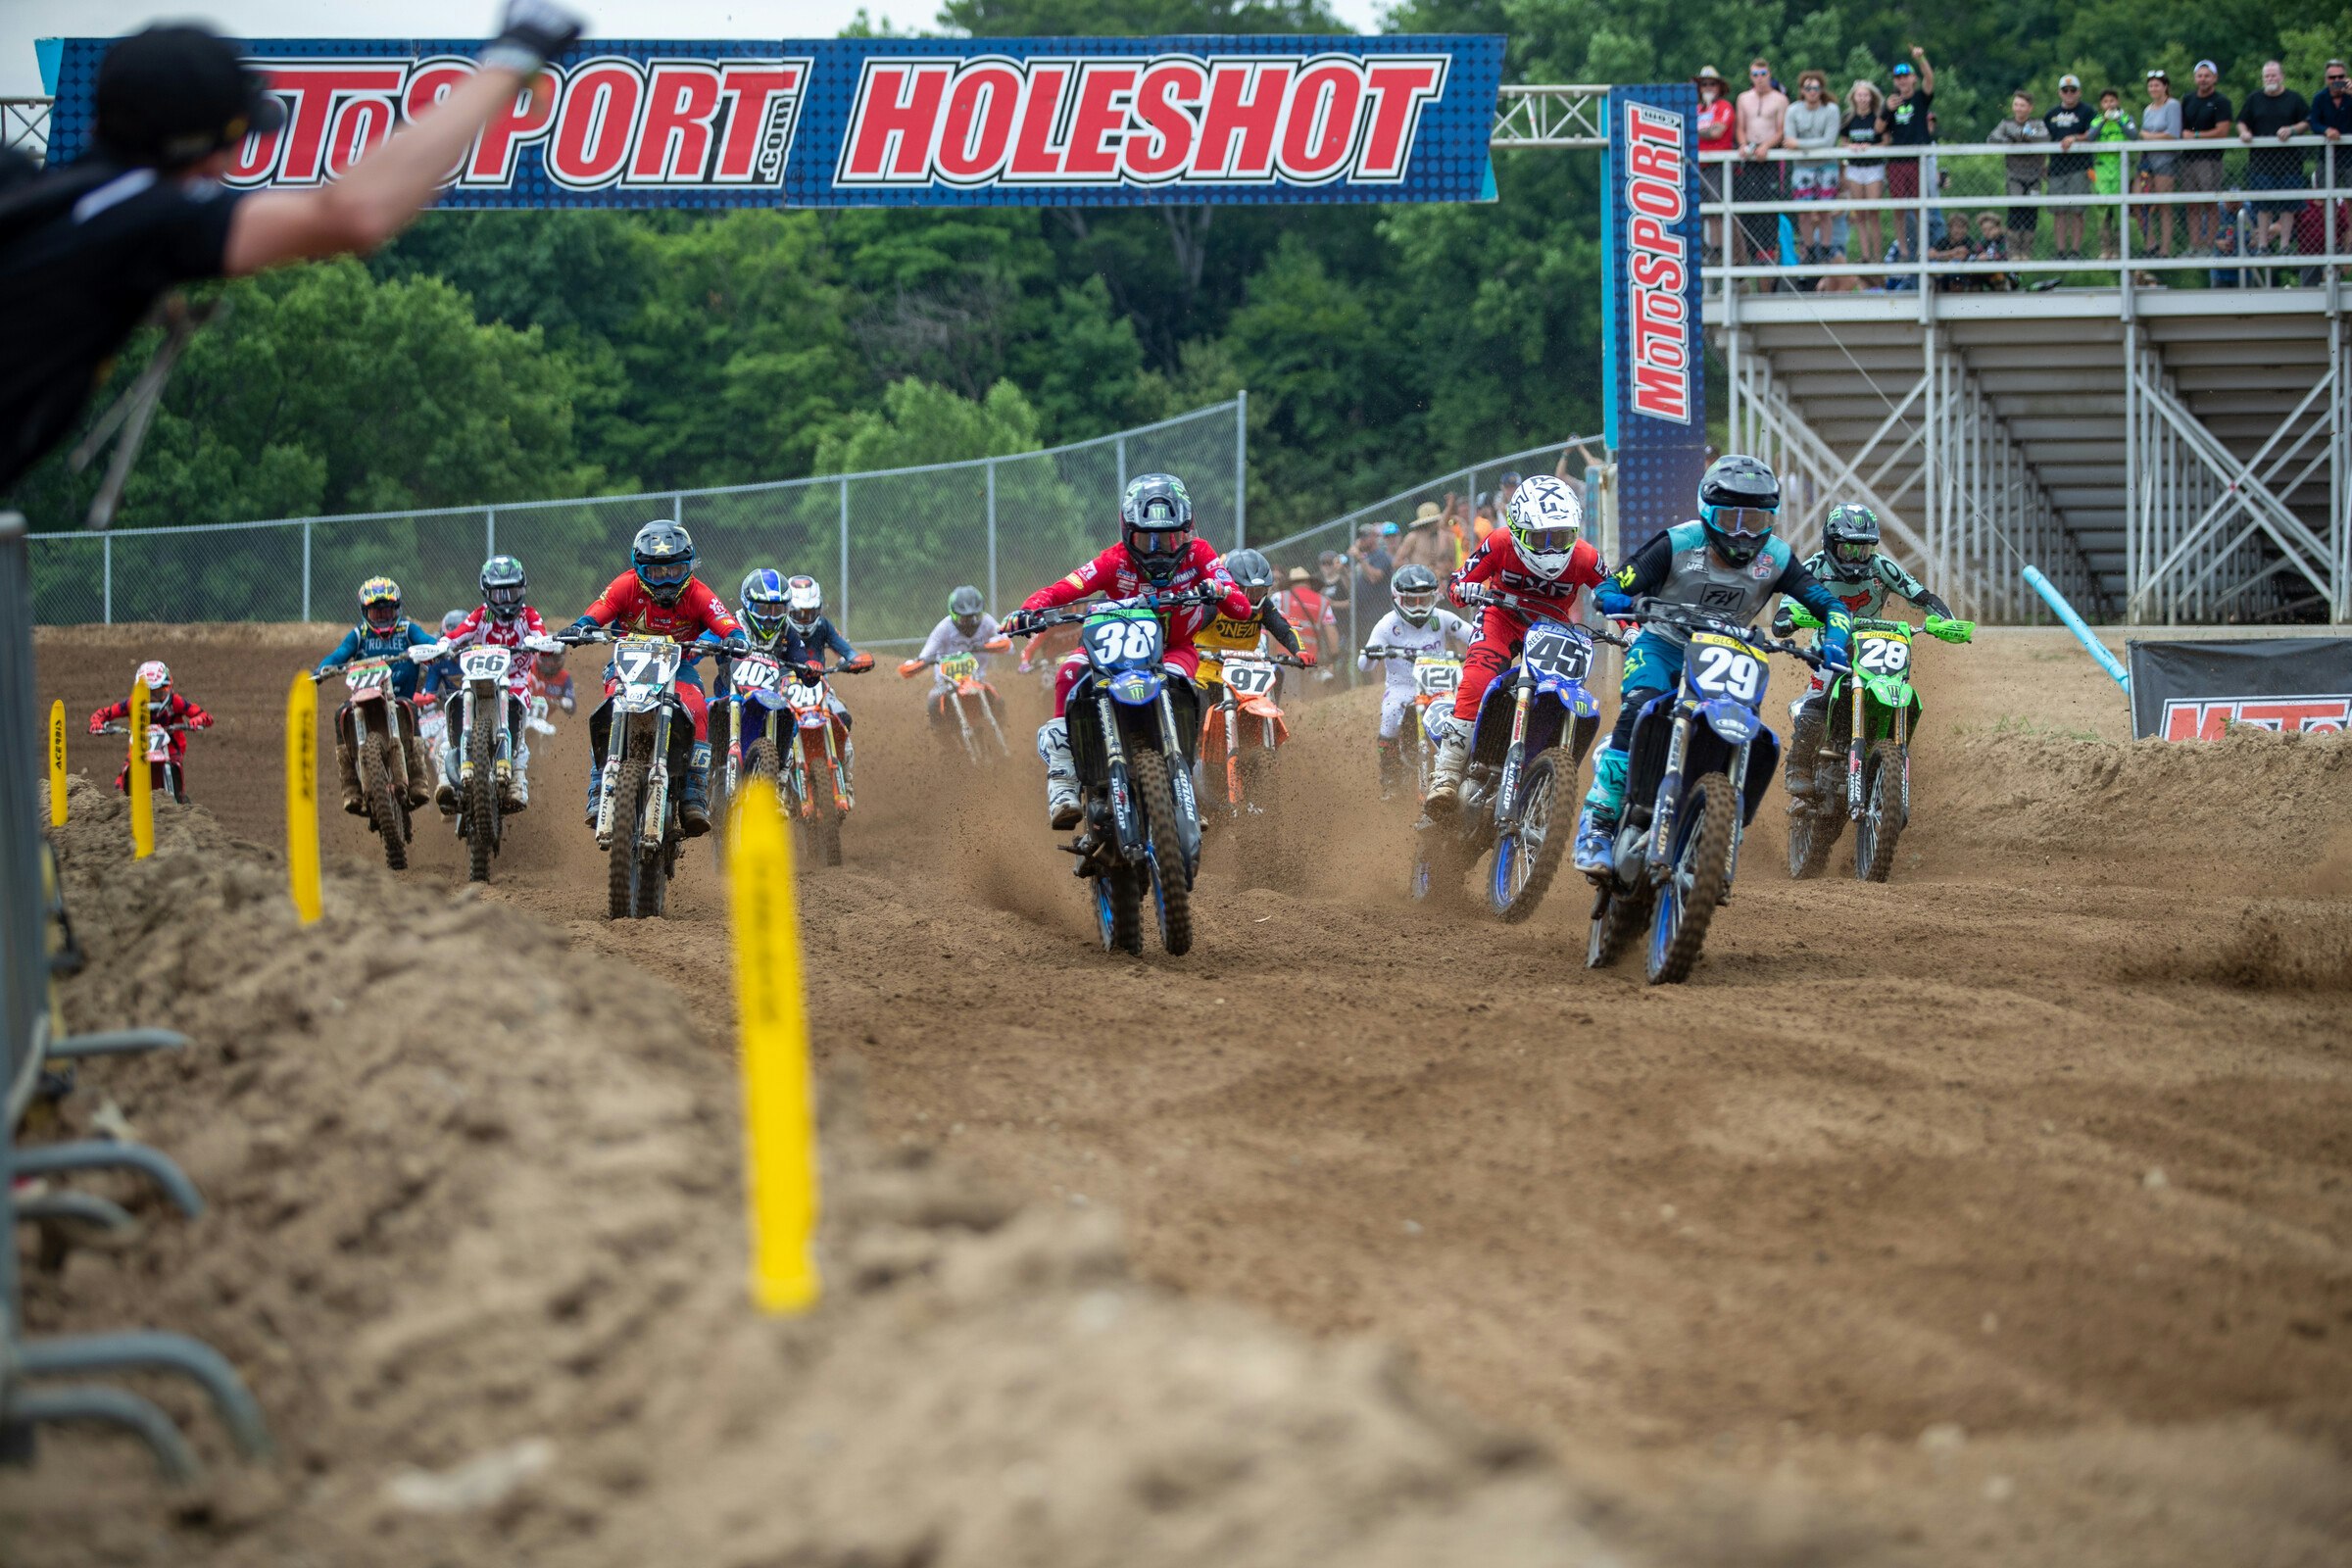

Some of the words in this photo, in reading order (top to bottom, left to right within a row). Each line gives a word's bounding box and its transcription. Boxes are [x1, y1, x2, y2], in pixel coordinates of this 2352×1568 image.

[221, 59, 811, 188] OTOPORT
[839, 59, 1448, 184] HOLESHOT
[1172, 568, 1198, 584] YAMAHA
[1501, 568, 1574, 597] FXR
[1704, 590, 1740, 606] FLY
[1094, 620, 1156, 663] 38
[1527, 630, 1544, 648] REED
[1712, 635, 1750, 652] GLOVE
[1869, 631, 1897, 640] GLOVER
[466, 655, 505, 673] 66
[623, 652, 672, 684] 71
[1527, 635, 1591, 678] 45
[1859, 638, 1908, 670] 28
[732, 661, 779, 691] 402
[1231, 668, 1271, 692] 97
[1695, 647, 1759, 700] 29
[787, 682, 823, 708] 241
[652, 786, 662, 828] DUNLOP
[1111, 777, 1126, 830] DUNLOP
[1178, 768, 1196, 821] DUNLOP
